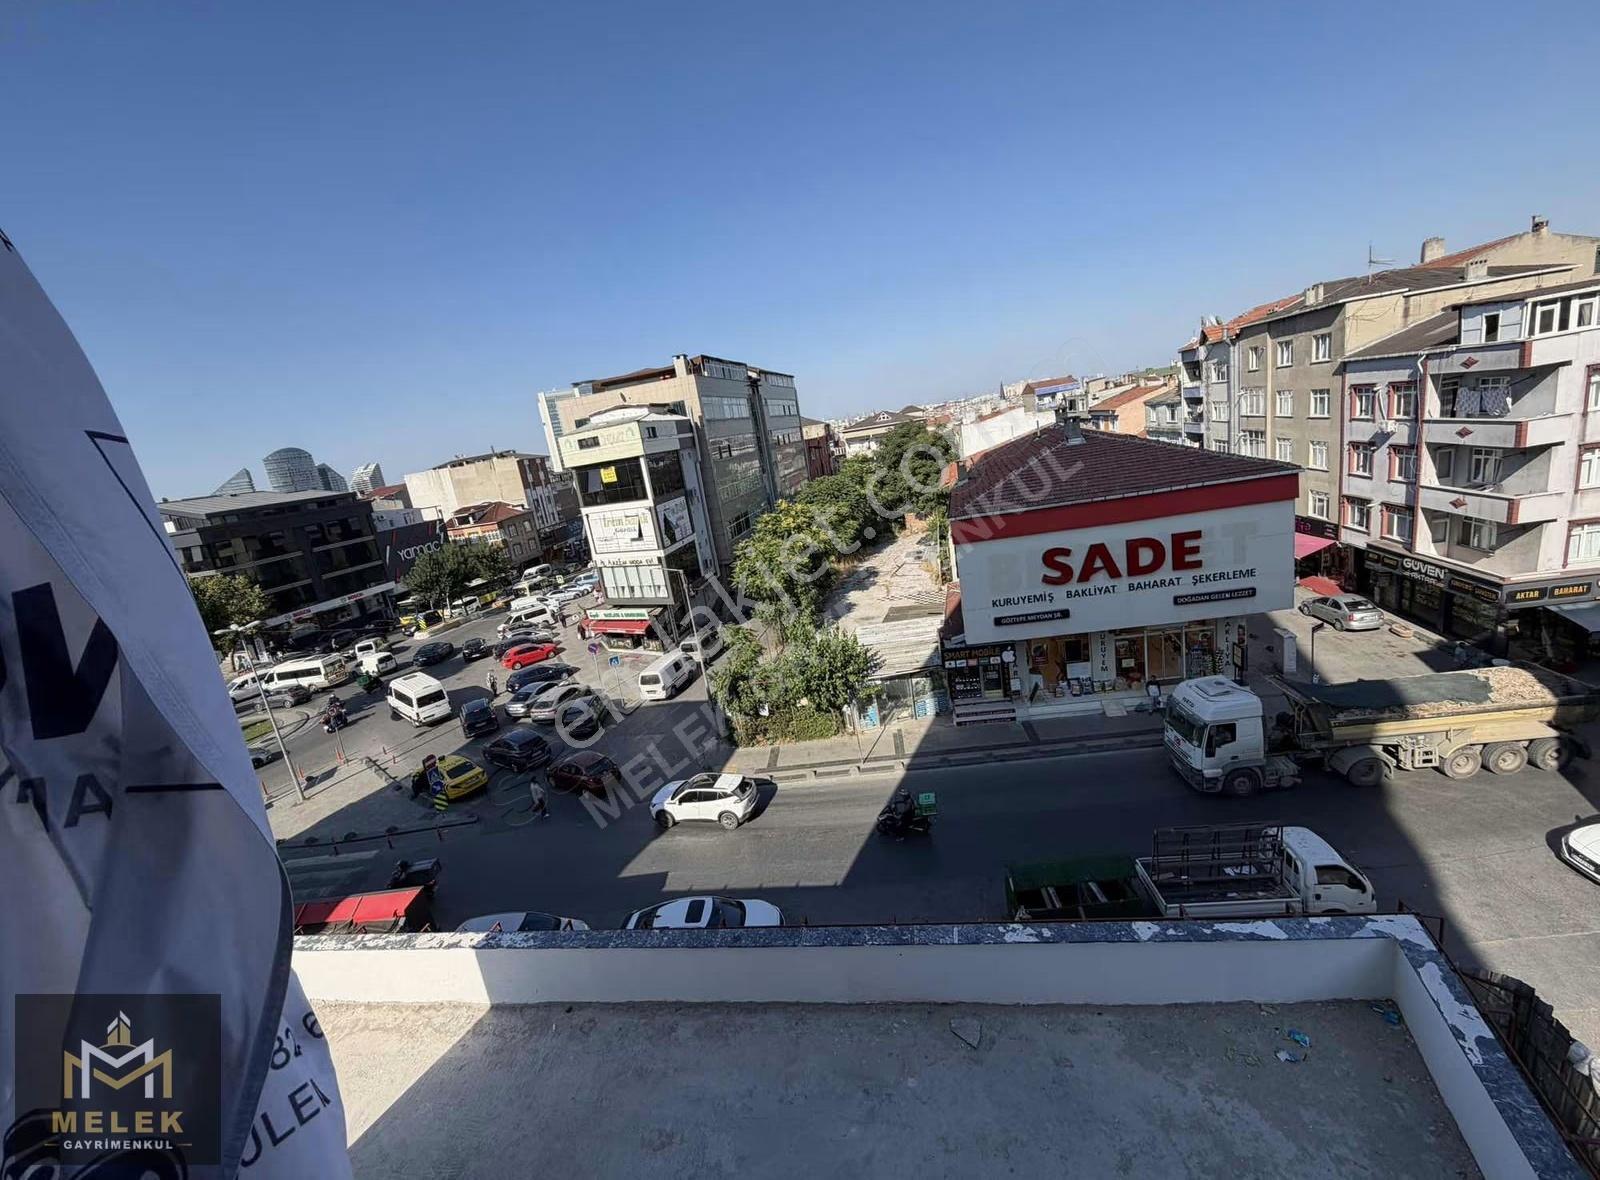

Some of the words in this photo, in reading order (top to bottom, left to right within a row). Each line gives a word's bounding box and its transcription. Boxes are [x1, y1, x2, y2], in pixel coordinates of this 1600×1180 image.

[1041, 530, 1203, 586] SADE
[1402, 558, 1445, 579] GÜVEN
[991, 591, 1055, 608] KURUYEMİŞ
[1066, 584, 1118, 599] BAKLİYAT
[1128, 576, 1182, 592] BAHARAT
[1191, 568, 1257, 586] ŞEKERLEME
[1515, 590, 1540, 600] AKTAR
[1554, 585, 1587, 596] BAHARAT
[944, 650, 969, 660] SMART
[971, 646, 1000, 658] MOBİLE
